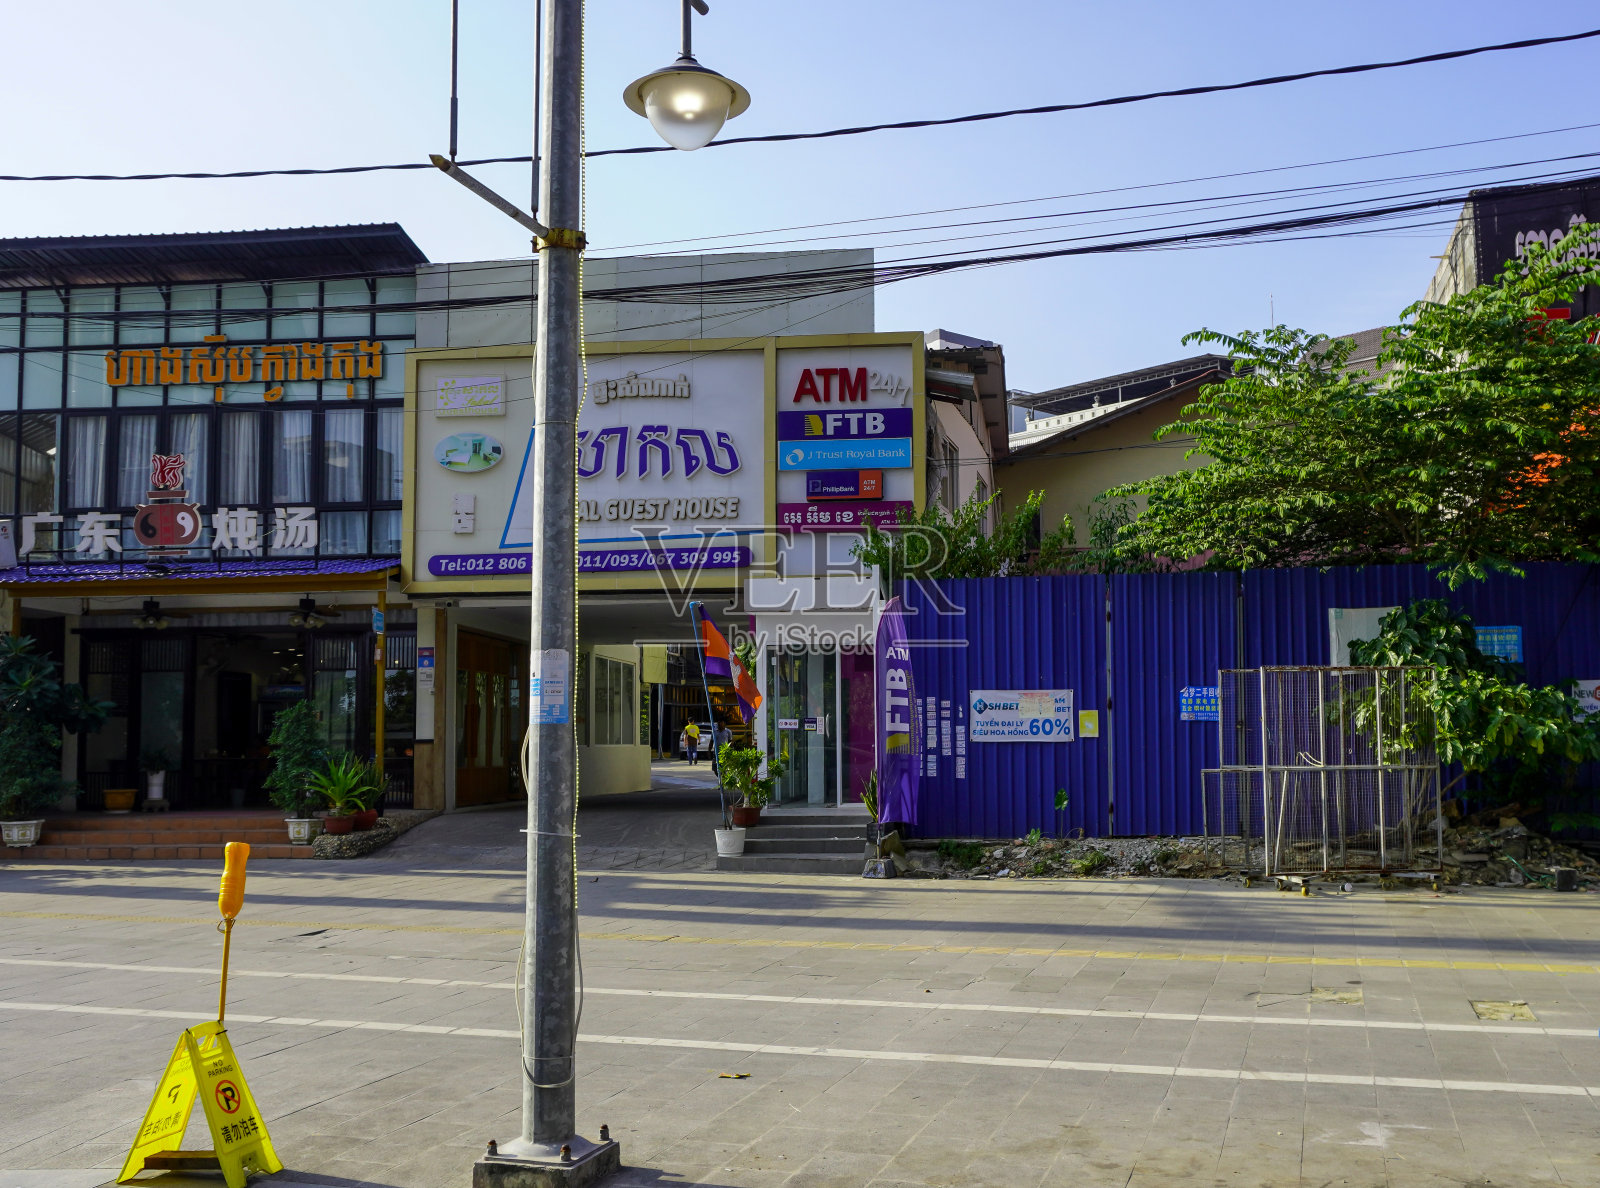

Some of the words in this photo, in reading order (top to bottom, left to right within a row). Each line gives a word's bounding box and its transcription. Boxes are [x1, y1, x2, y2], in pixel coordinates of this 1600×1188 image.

[792, 367, 867, 403] ATM
[869, 370, 911, 406] 24/7
[826, 413, 885, 436] FTB
[807, 450, 813, 459] J
[816, 450, 843, 459] Trust
[846, 449, 876, 460] Royal
[877, 448, 906, 459] Bank
[604, 498, 670, 521] GUEST
[671, 497, 740, 520] HOUSE
[439, 558, 494, 572] Tel:012
[498, 557, 527, 570] 806
[679, 552, 708, 565] 309
[712, 551, 741, 564] 995
[885, 668, 910, 732] FTB
[1029, 718, 1071, 736] 60%
[207, 1065, 234, 1078] PARKING
[213, 1059, 224, 1068] NO
[221, 1115, 259, 1145] 请勿泊车
